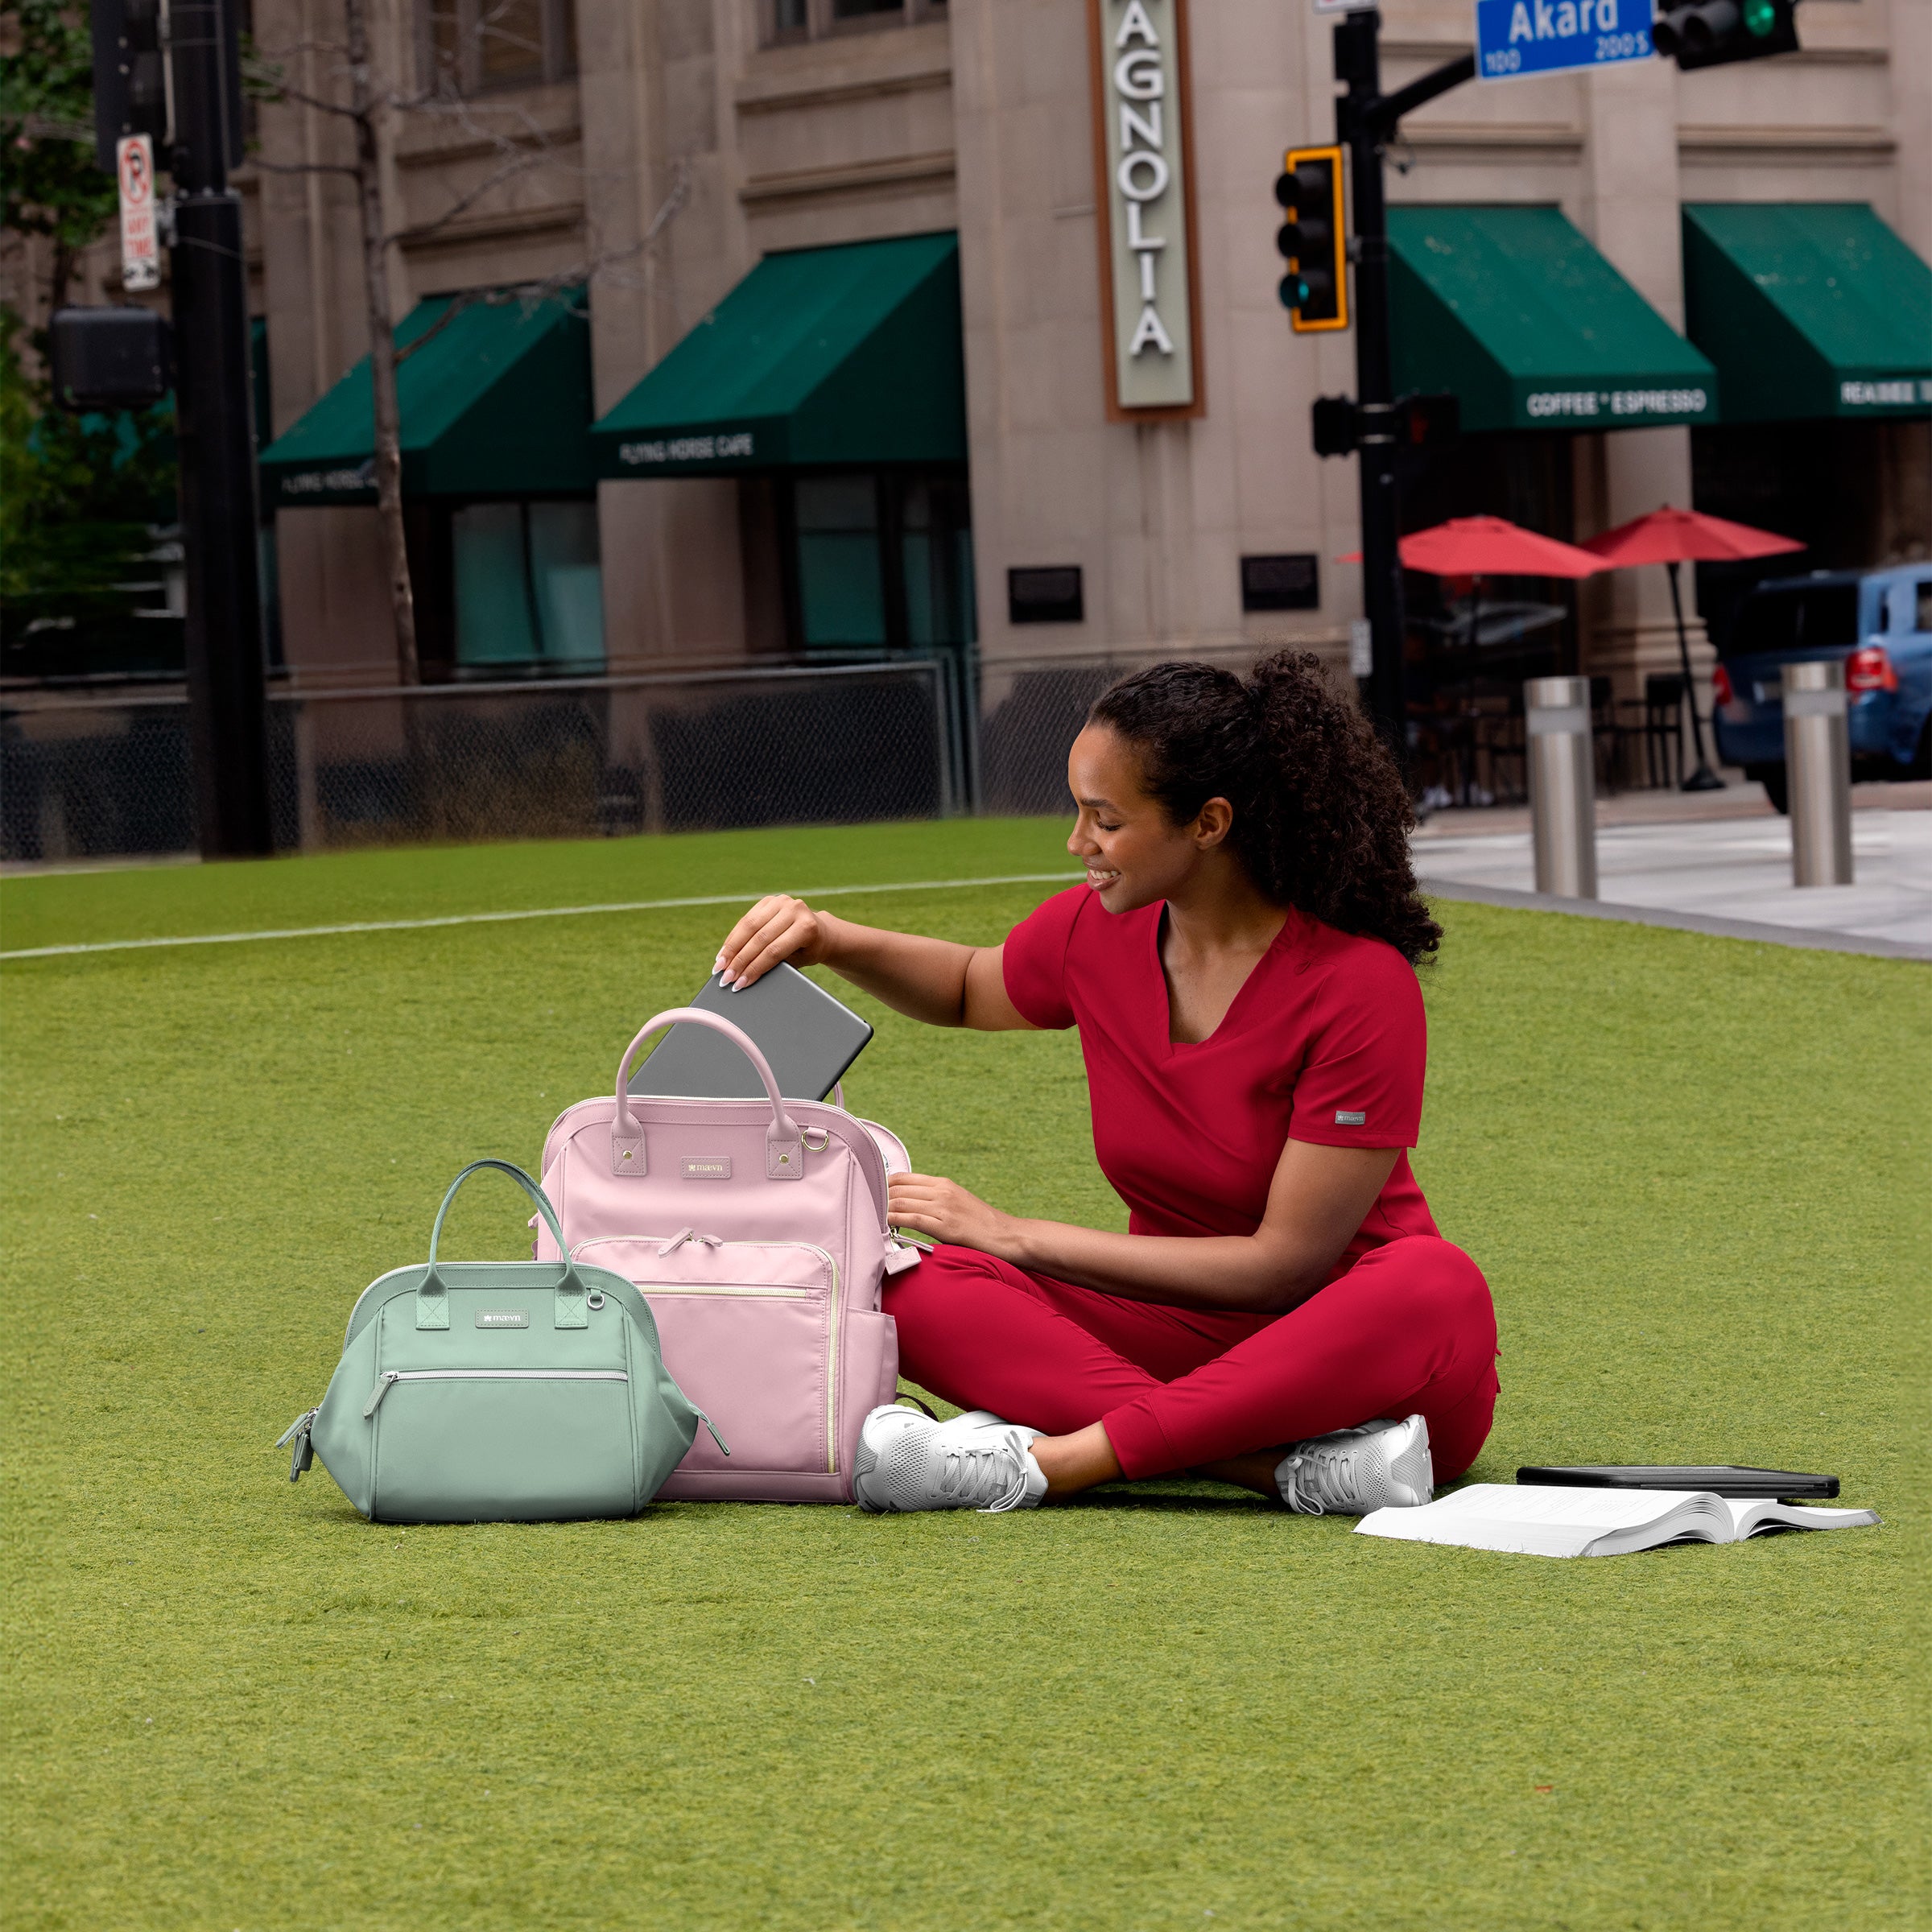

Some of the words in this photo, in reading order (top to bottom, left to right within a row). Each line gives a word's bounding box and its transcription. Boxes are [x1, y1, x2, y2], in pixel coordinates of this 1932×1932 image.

[1509, 0, 1618, 43] Akard
[1113, 0, 1174, 354] AGNOLIA
[1526, 391, 1600, 417] COFFEE
[1612, 388, 1707, 415] ESPRESSO
